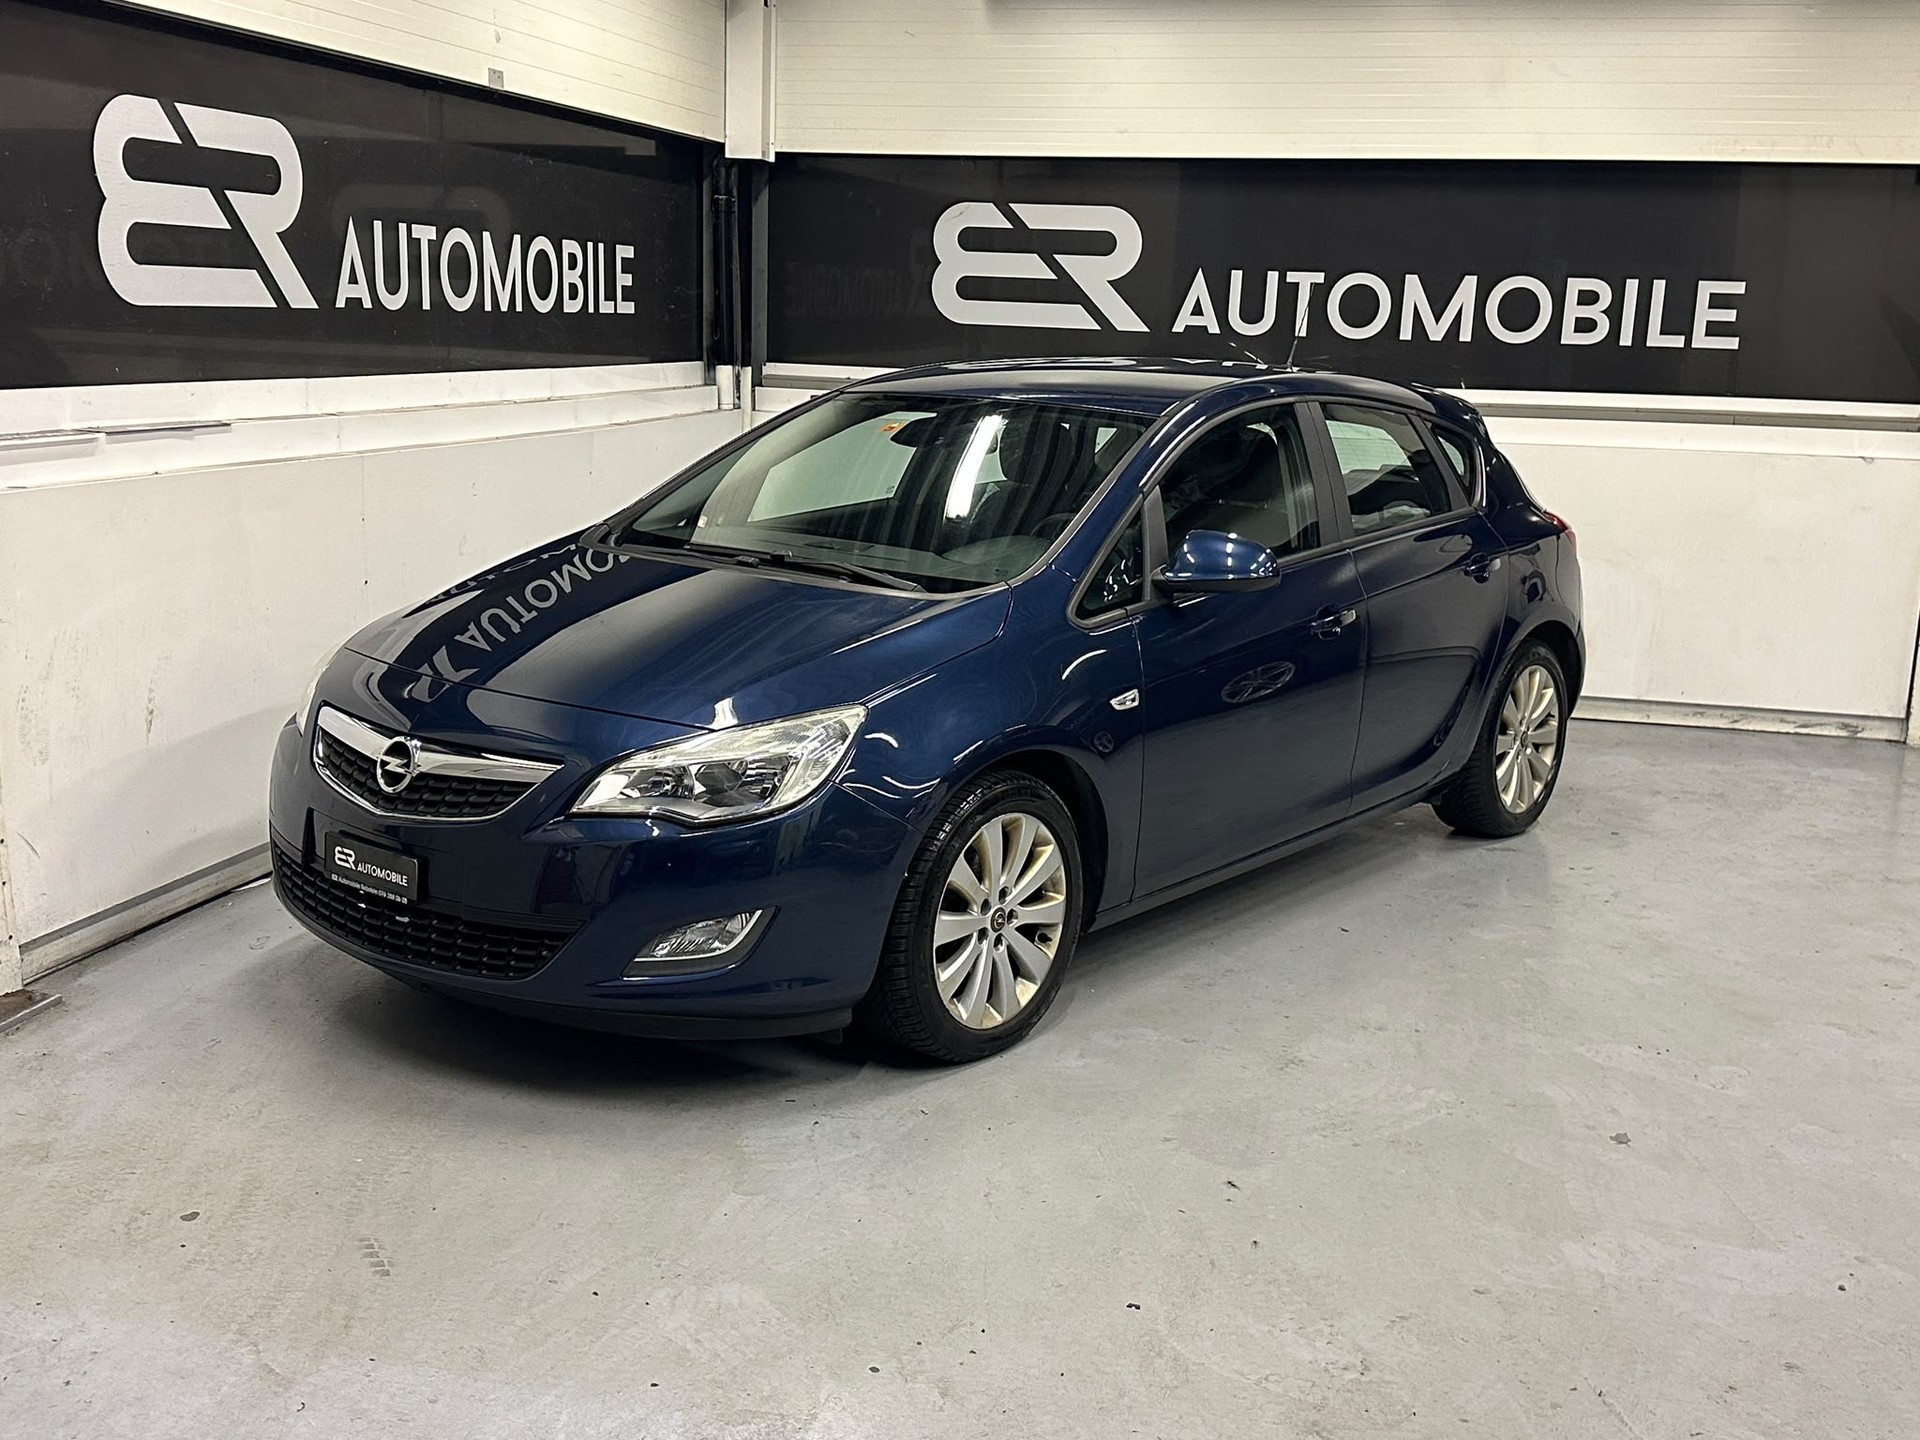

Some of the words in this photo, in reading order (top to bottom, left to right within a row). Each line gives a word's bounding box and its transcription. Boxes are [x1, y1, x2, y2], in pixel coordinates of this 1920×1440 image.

[336, 216, 635, 314] AUTOMOBILE
[1172, 267, 1747, 350] AUTOMOBILE
[357, 862, 408, 887] AUTOMOBILE
